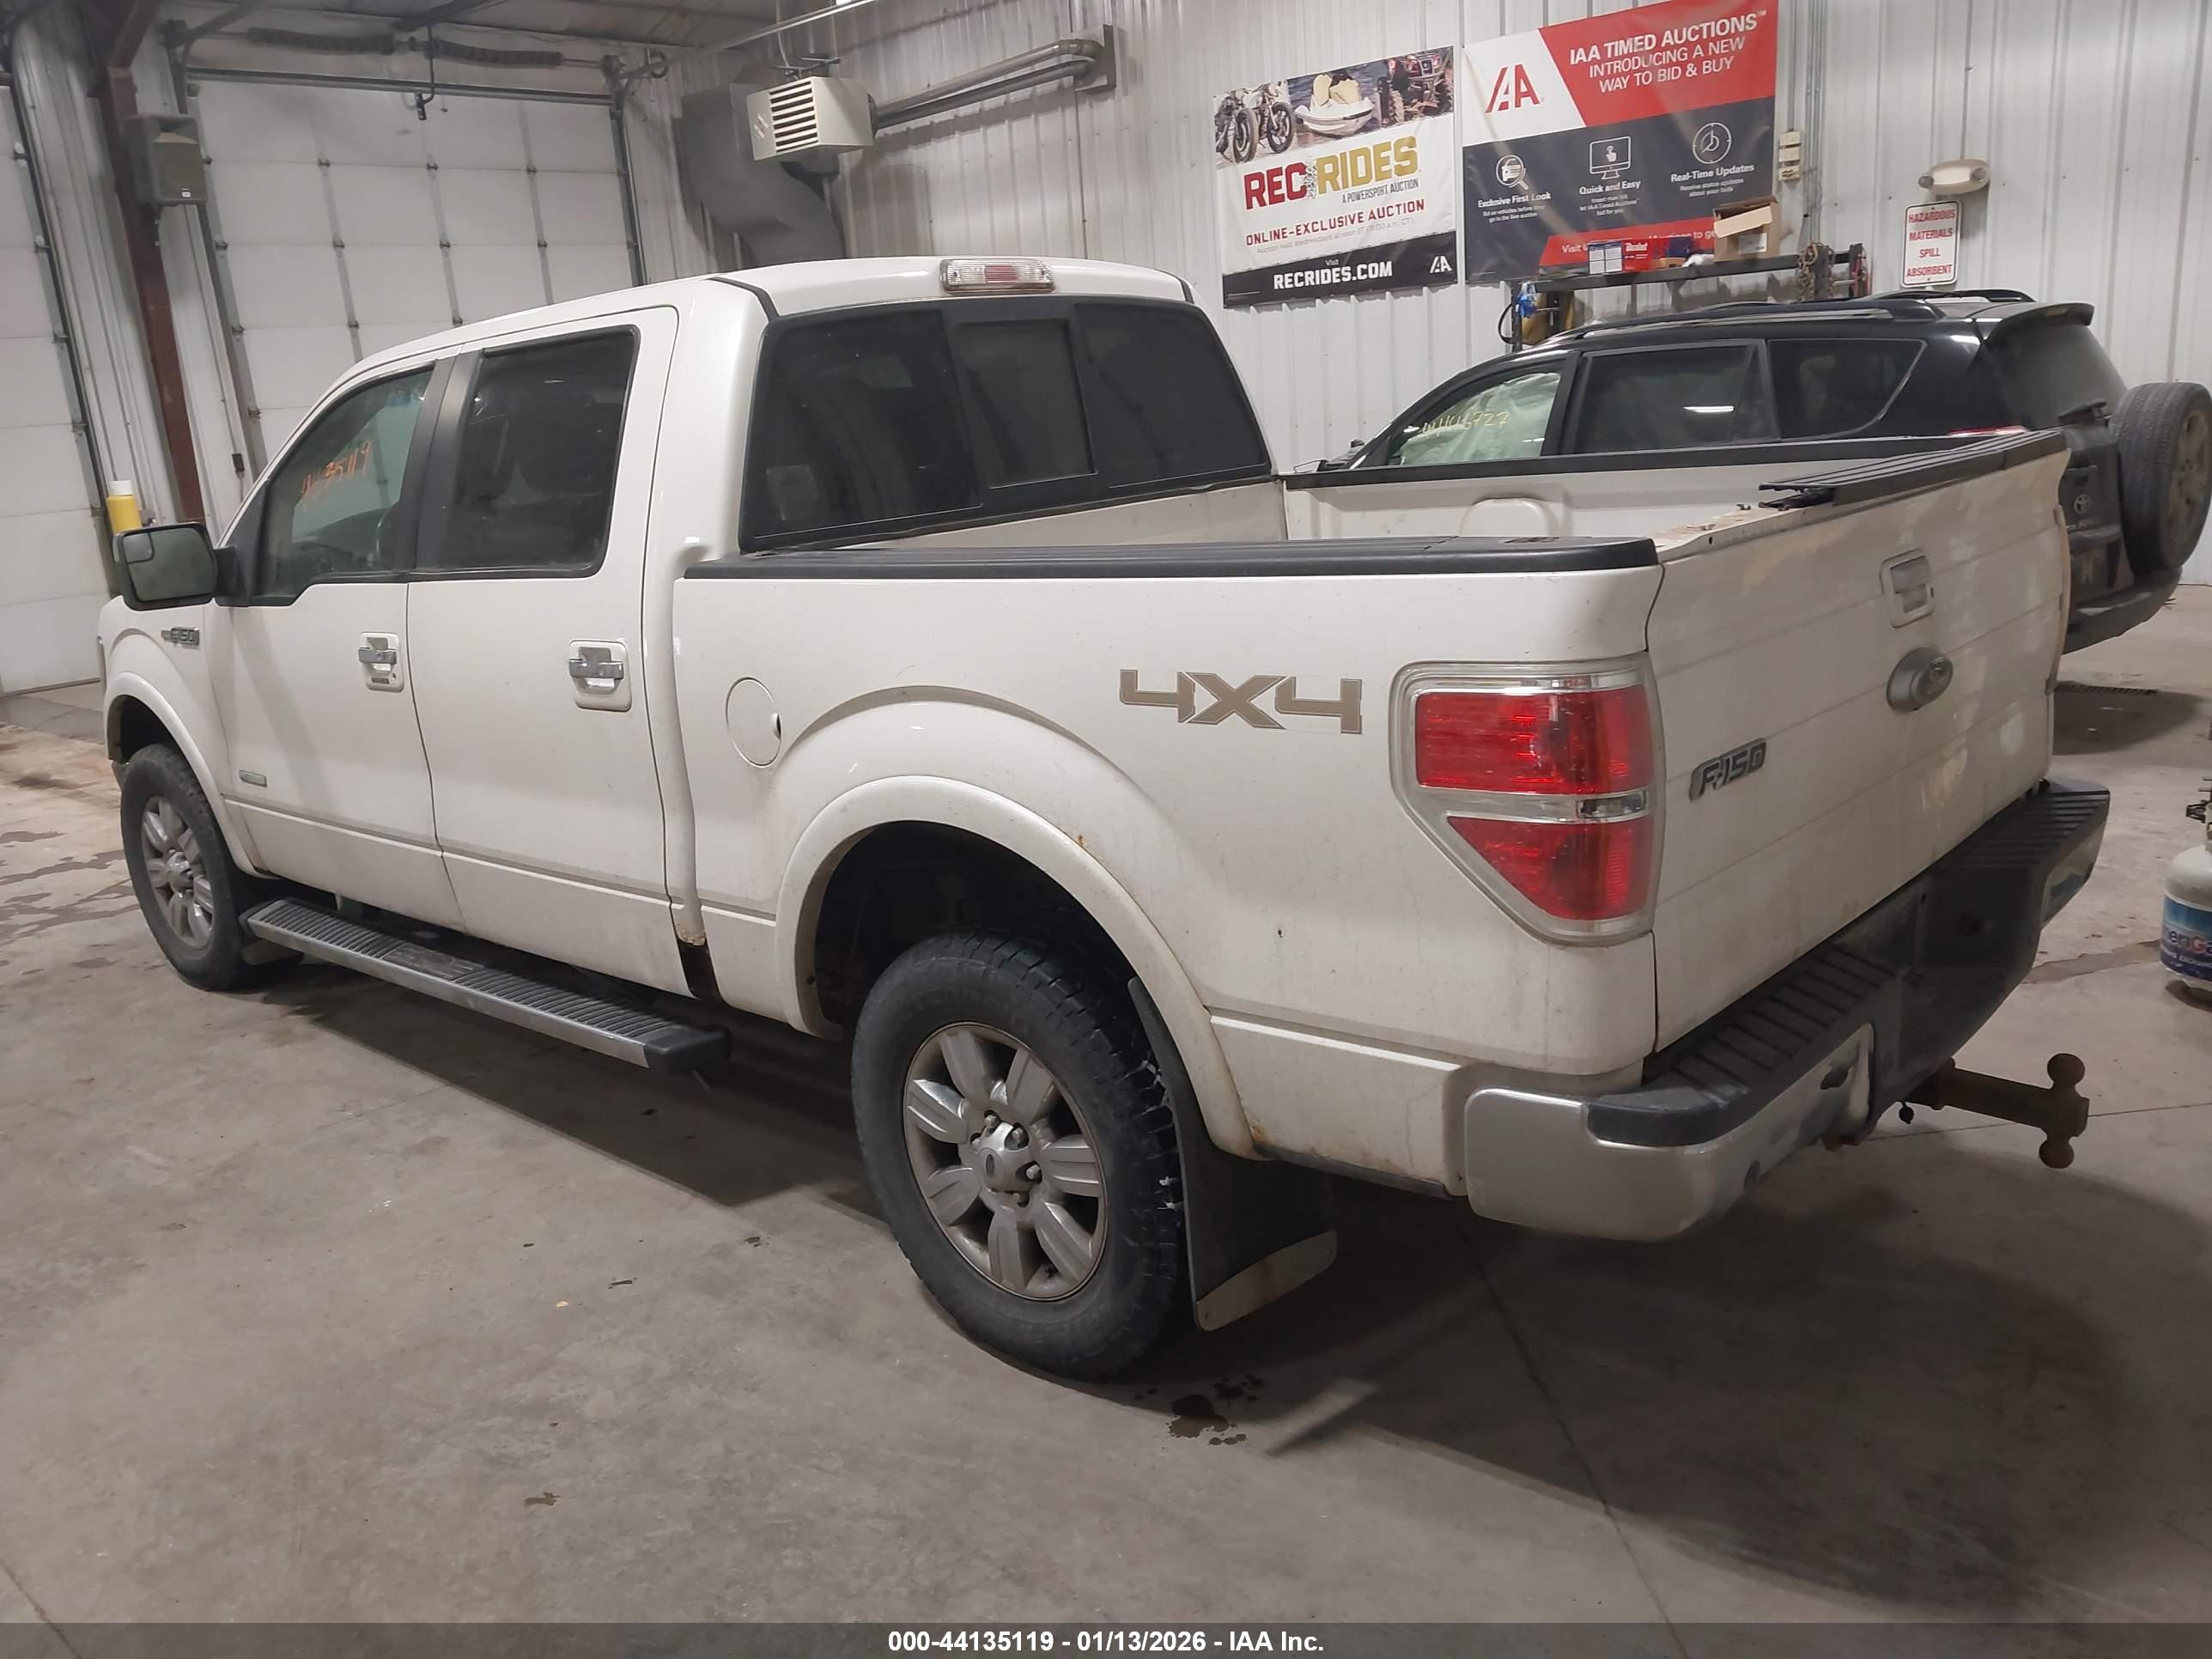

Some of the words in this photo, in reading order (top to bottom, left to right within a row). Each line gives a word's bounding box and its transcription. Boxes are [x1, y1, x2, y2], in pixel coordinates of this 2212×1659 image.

[1570, 45, 1601, 65] IAA
[1603, 34, 1656, 58] TIMED
[1589, 47, 1688, 78] INTRODUCING
[1692, 45, 1704, 59] A
[1708, 36, 1746, 56] NEW
[1599, 75, 1631, 93] WAY
[1634, 70, 1652, 87] TO
[1657, 65, 1681, 82] BID
[1686, 64, 1698, 78] &
[1702, 56, 1735, 76] BUY
[1243, 161, 1308, 210] REC
[1316, 136, 1418, 195] RIDES
[1670, 170, 1714, 182] Real-Time
[1716, 164, 1755, 177] Updates
[1346, 185, 1389, 204] POWERSPORT
[1390, 178, 1419, 194] AUCTION
[1579, 185, 1605, 196] Quick
[1605, 183, 1620, 192] and
[1621, 179, 1641, 191] Easy
[1477, 198, 1511, 209] Exclusive
[1511, 194, 1529, 204] First
[1531, 191, 1552, 202] Look
[1246, 211, 1364, 246] ONLINE-EXCLUSIVE
[1368, 198, 1425, 222] AUCTION
[1908, 209, 1956, 223] HAZARDOUS
[1693, 231, 1703, 240] to
[1909, 228, 1954, 241] MATERIALS
[1561, 243, 1582, 253] Visit
[1918, 247, 1942, 258] SPILL
[1273, 260, 1393, 290] RECRIDES.COM
[1906, 264, 1954, 277] ABSORBENT
[1120, 669, 1362, 734] 4X4
